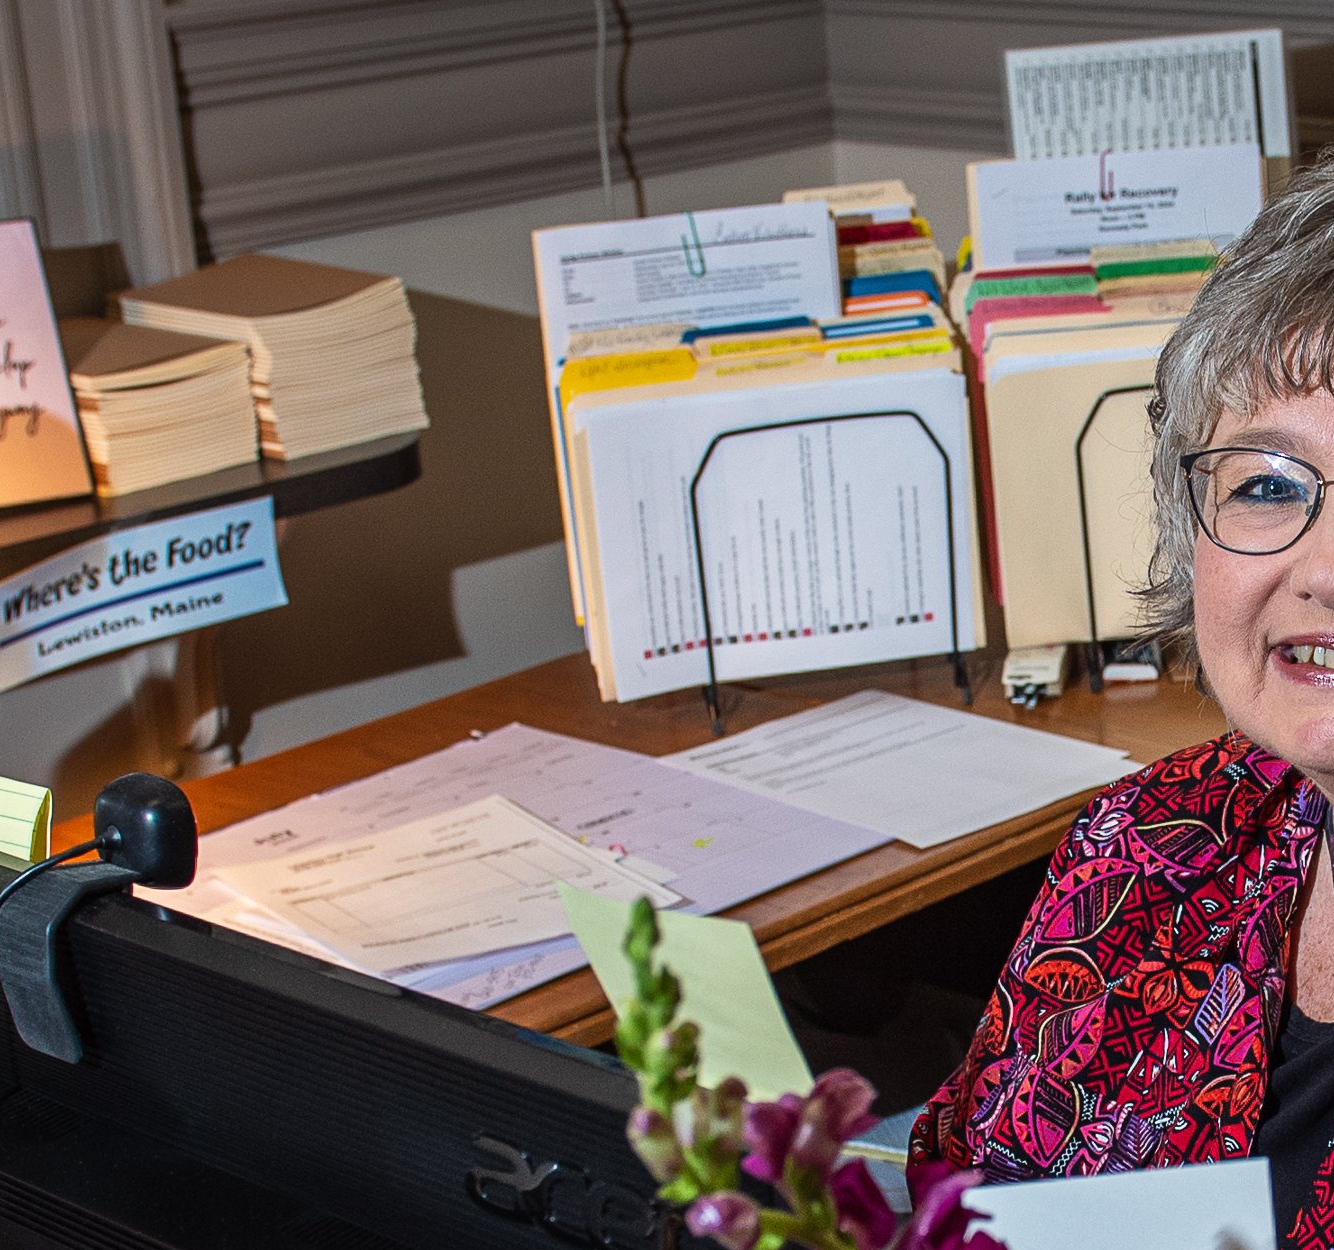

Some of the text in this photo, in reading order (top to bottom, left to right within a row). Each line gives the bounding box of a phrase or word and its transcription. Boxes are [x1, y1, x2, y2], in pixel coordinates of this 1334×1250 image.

[3, 521, 252, 625] Where's the Food?
[150, 592, 224, 621] Maine
